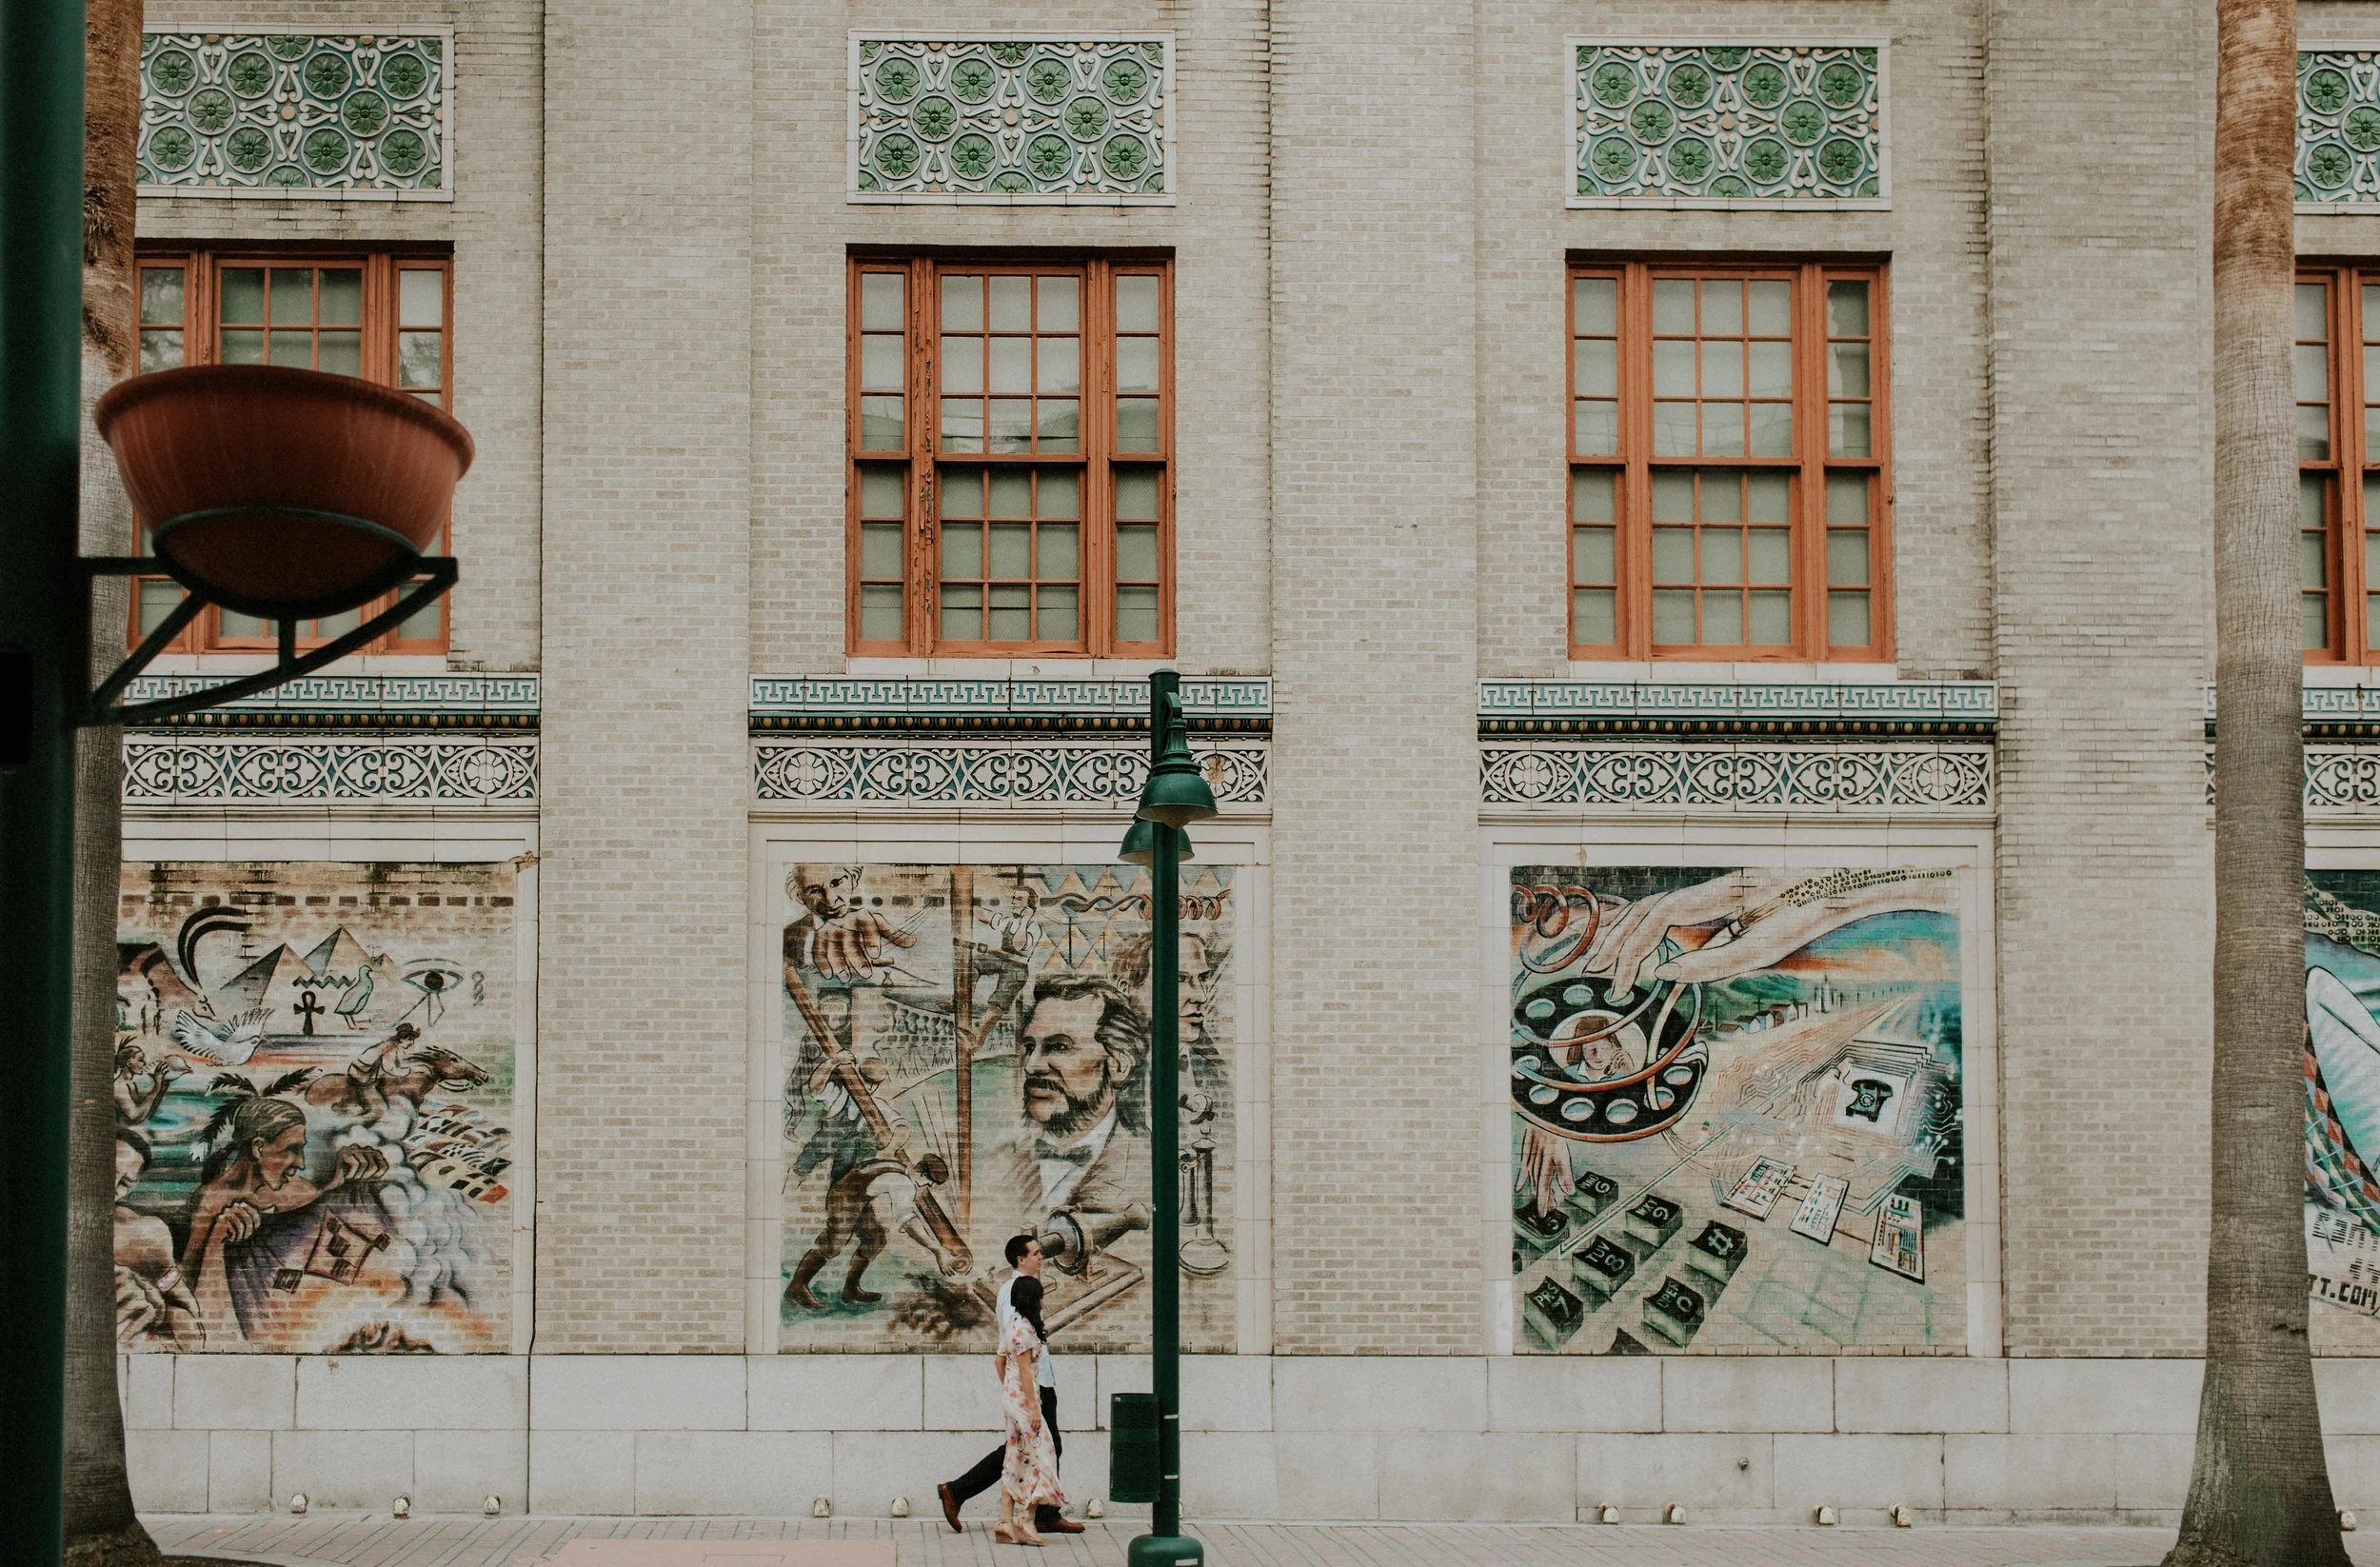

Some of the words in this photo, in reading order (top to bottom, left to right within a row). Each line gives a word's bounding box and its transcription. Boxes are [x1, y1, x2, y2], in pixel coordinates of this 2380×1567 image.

[1635, 1199, 1658, 1217] WXY
[1652, 1206, 1669, 1220] 9
[1585, 1240, 1611, 1263] TUV
[1604, 1254, 1625, 1272] 8
[1534, 1281, 1558, 1308] PRS
[1551, 1295, 1570, 1319] 7
